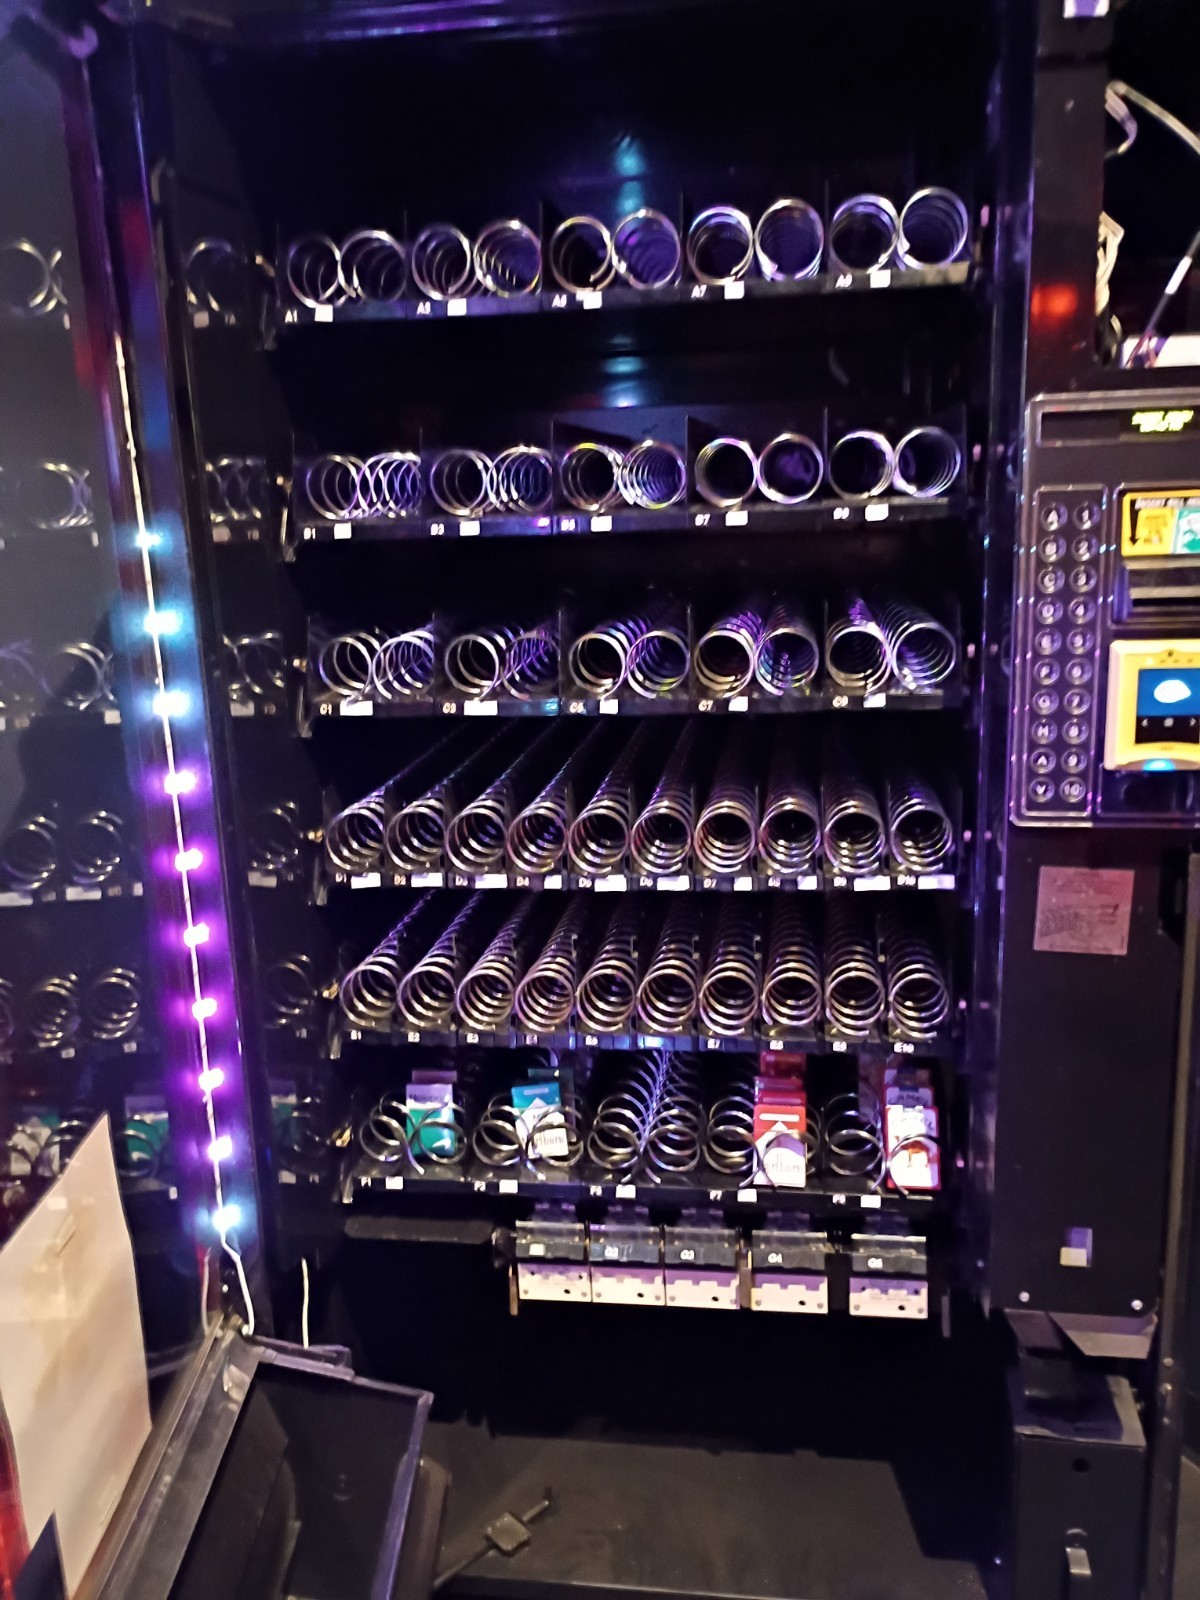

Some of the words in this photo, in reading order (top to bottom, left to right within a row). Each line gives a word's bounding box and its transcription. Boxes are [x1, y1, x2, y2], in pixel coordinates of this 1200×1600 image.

[285, 310, 298, 323] A1
[303, 527, 316, 540] B1
[335, 872, 347, 883] D1
